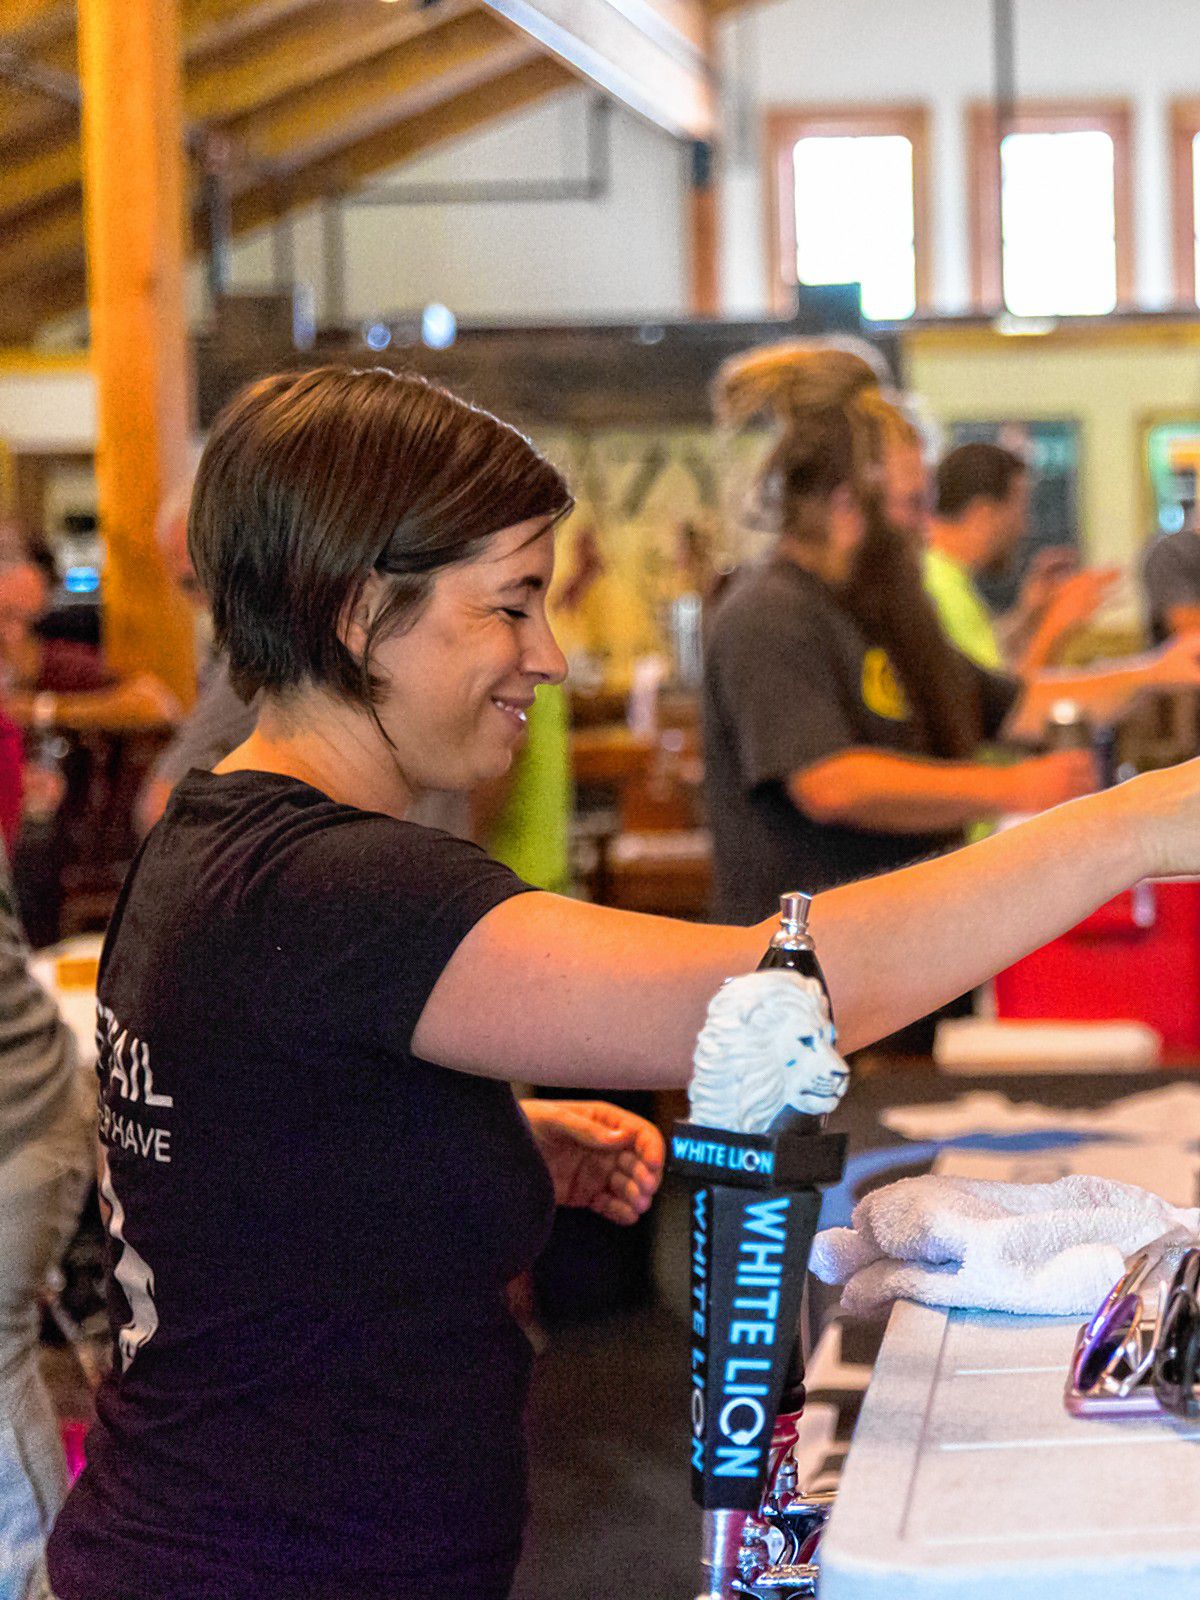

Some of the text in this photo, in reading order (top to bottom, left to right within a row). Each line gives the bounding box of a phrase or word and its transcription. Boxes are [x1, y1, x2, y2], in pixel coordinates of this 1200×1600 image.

[111, 1111, 172, 1163] HAVE
[671, 1136, 774, 1174] WHITE LION
[691, 1188, 707, 1472] WHITE LION
[712, 1197, 790, 1479] WHITE LION
